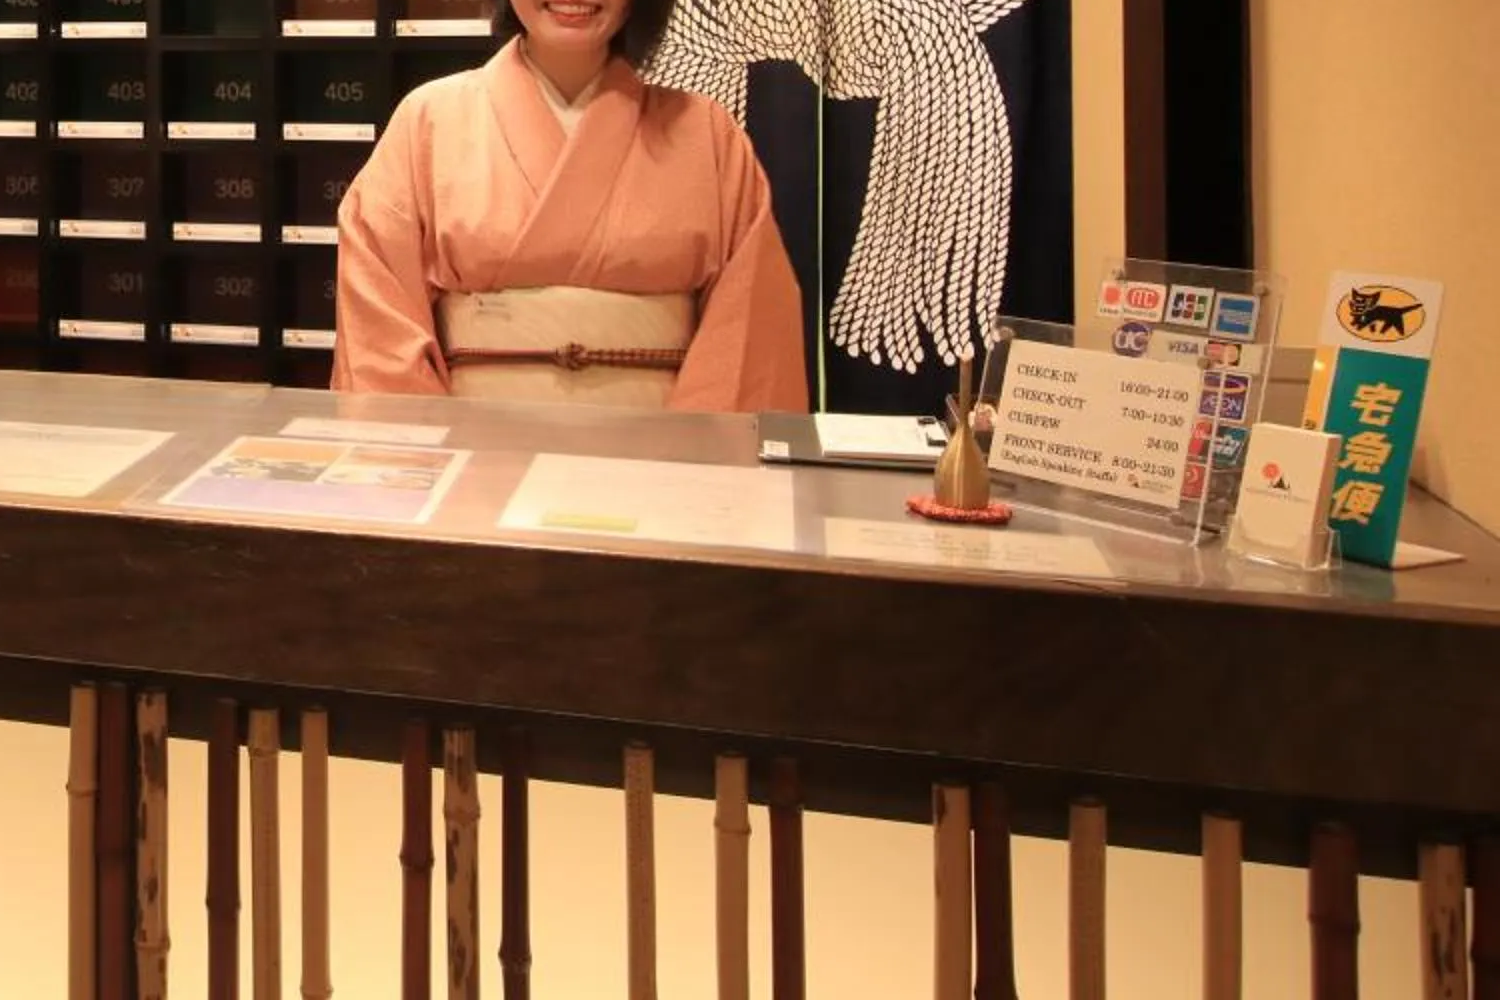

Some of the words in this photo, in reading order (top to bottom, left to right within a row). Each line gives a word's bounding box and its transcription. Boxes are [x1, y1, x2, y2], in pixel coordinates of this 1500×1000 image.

[4, 81, 40, 101] 402
[108, 81, 146, 101] 403
[214, 81, 253, 101] 404
[324, 81, 364, 102] 405
[214, 179, 255, 200] 308
[109, 273, 144, 293] 301
[215, 276, 255, 297] 302
[1167, 340, 1200, 355] VISA
[1007, 409, 1061, 430] CURFEW
[1003, 432, 1045, 452] FRONT
[1047, 441, 1104, 464] SERVICE
[1330, 381, 1403, 525] 宅急便
